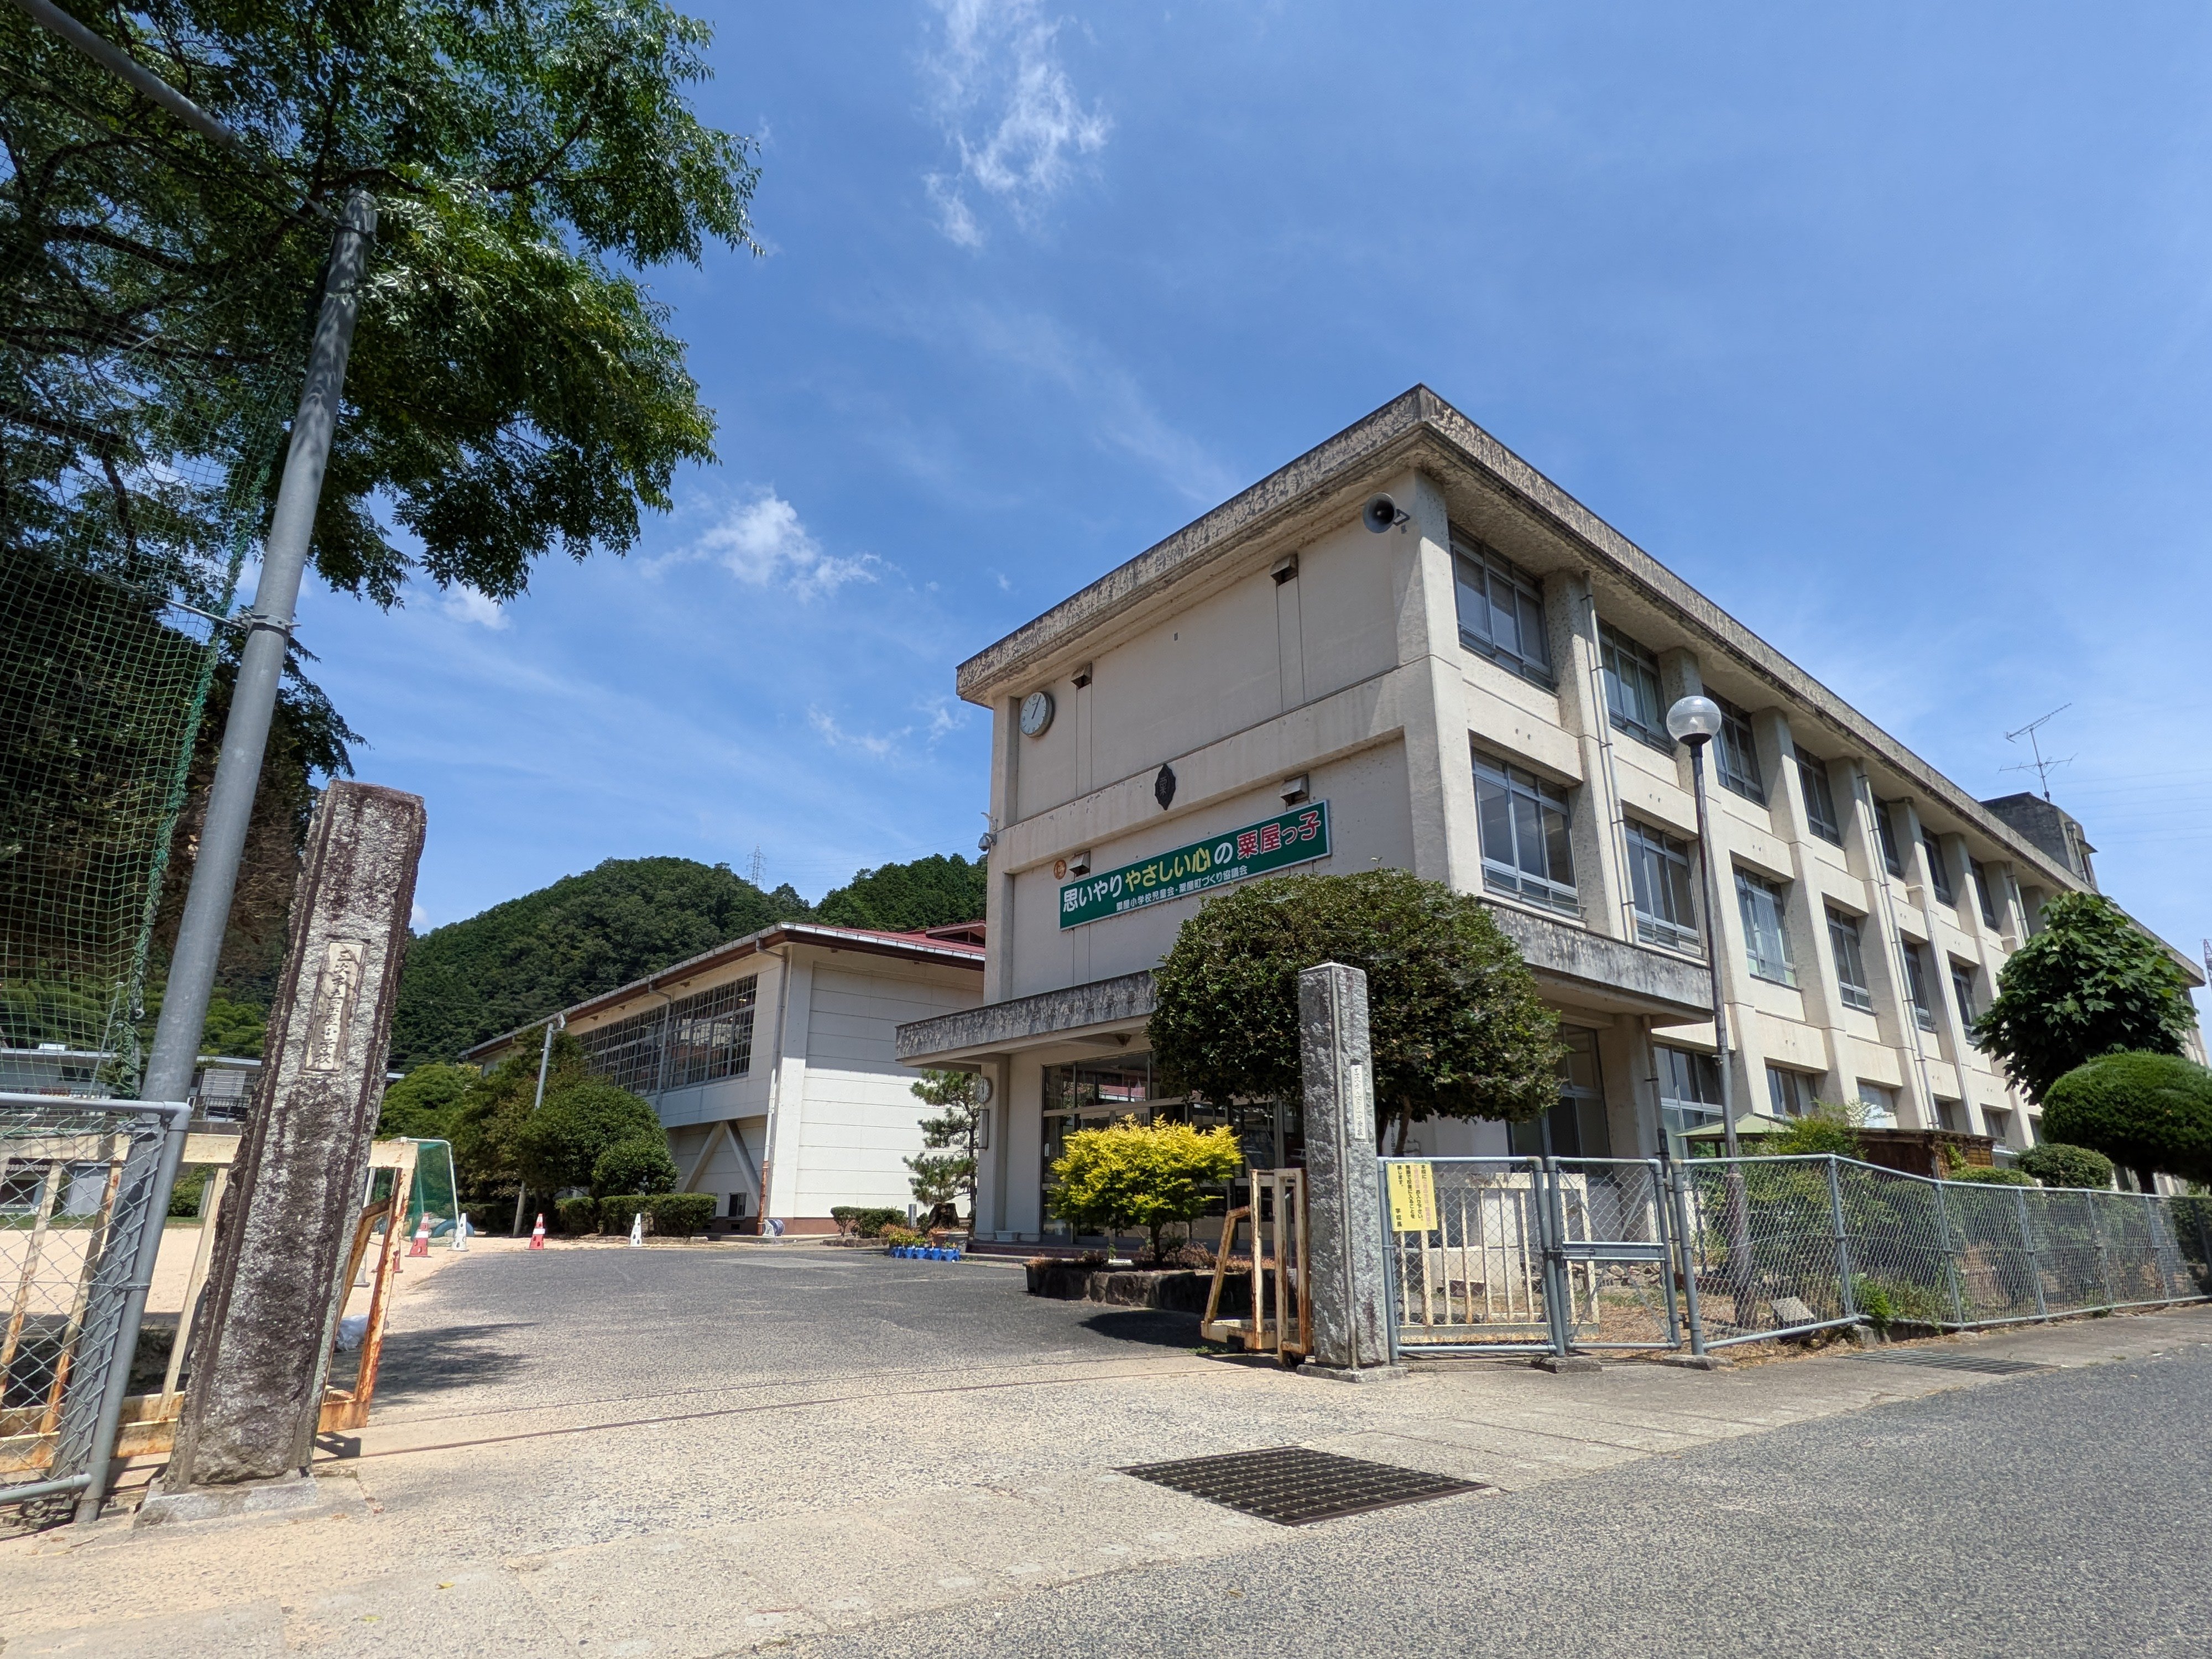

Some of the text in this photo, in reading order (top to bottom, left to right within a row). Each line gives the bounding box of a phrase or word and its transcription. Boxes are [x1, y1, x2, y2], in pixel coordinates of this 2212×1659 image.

[1062, 810, 1321, 913] 思いやりやさしい心の粟屋っ子
[314, 950, 354, 1064] 三次市立粟屋小学校
